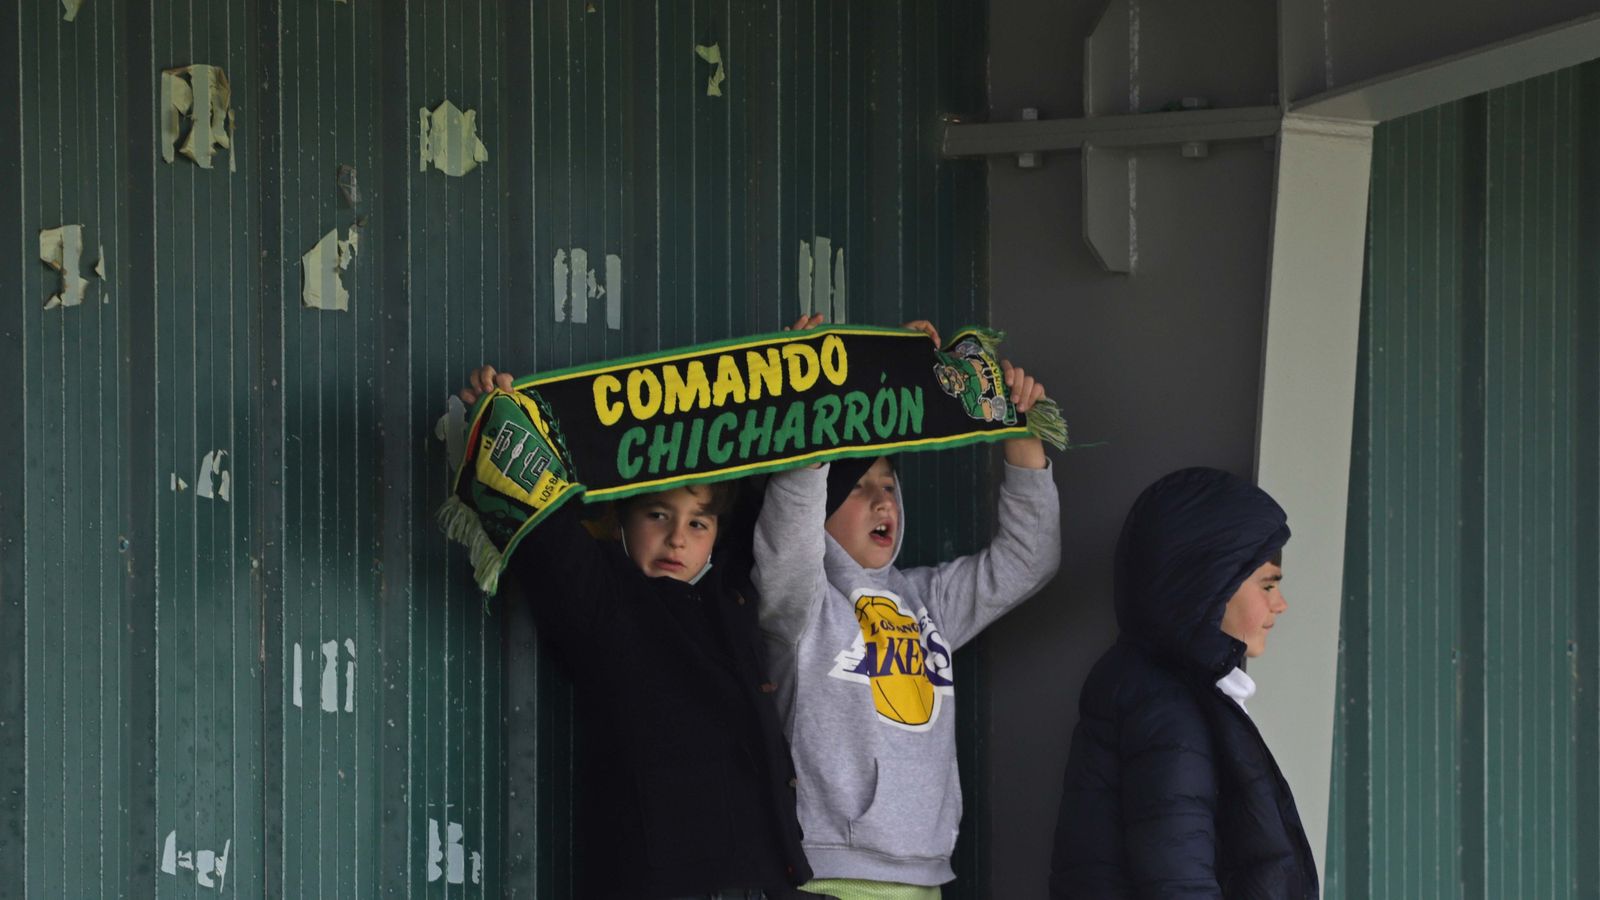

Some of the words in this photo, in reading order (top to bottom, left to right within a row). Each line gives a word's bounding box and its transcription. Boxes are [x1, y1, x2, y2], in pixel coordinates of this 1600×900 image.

[593, 334, 848, 426] COMANDO
[617, 371, 925, 479] CHICHARRÓN
[870, 619, 896, 636] LOS
